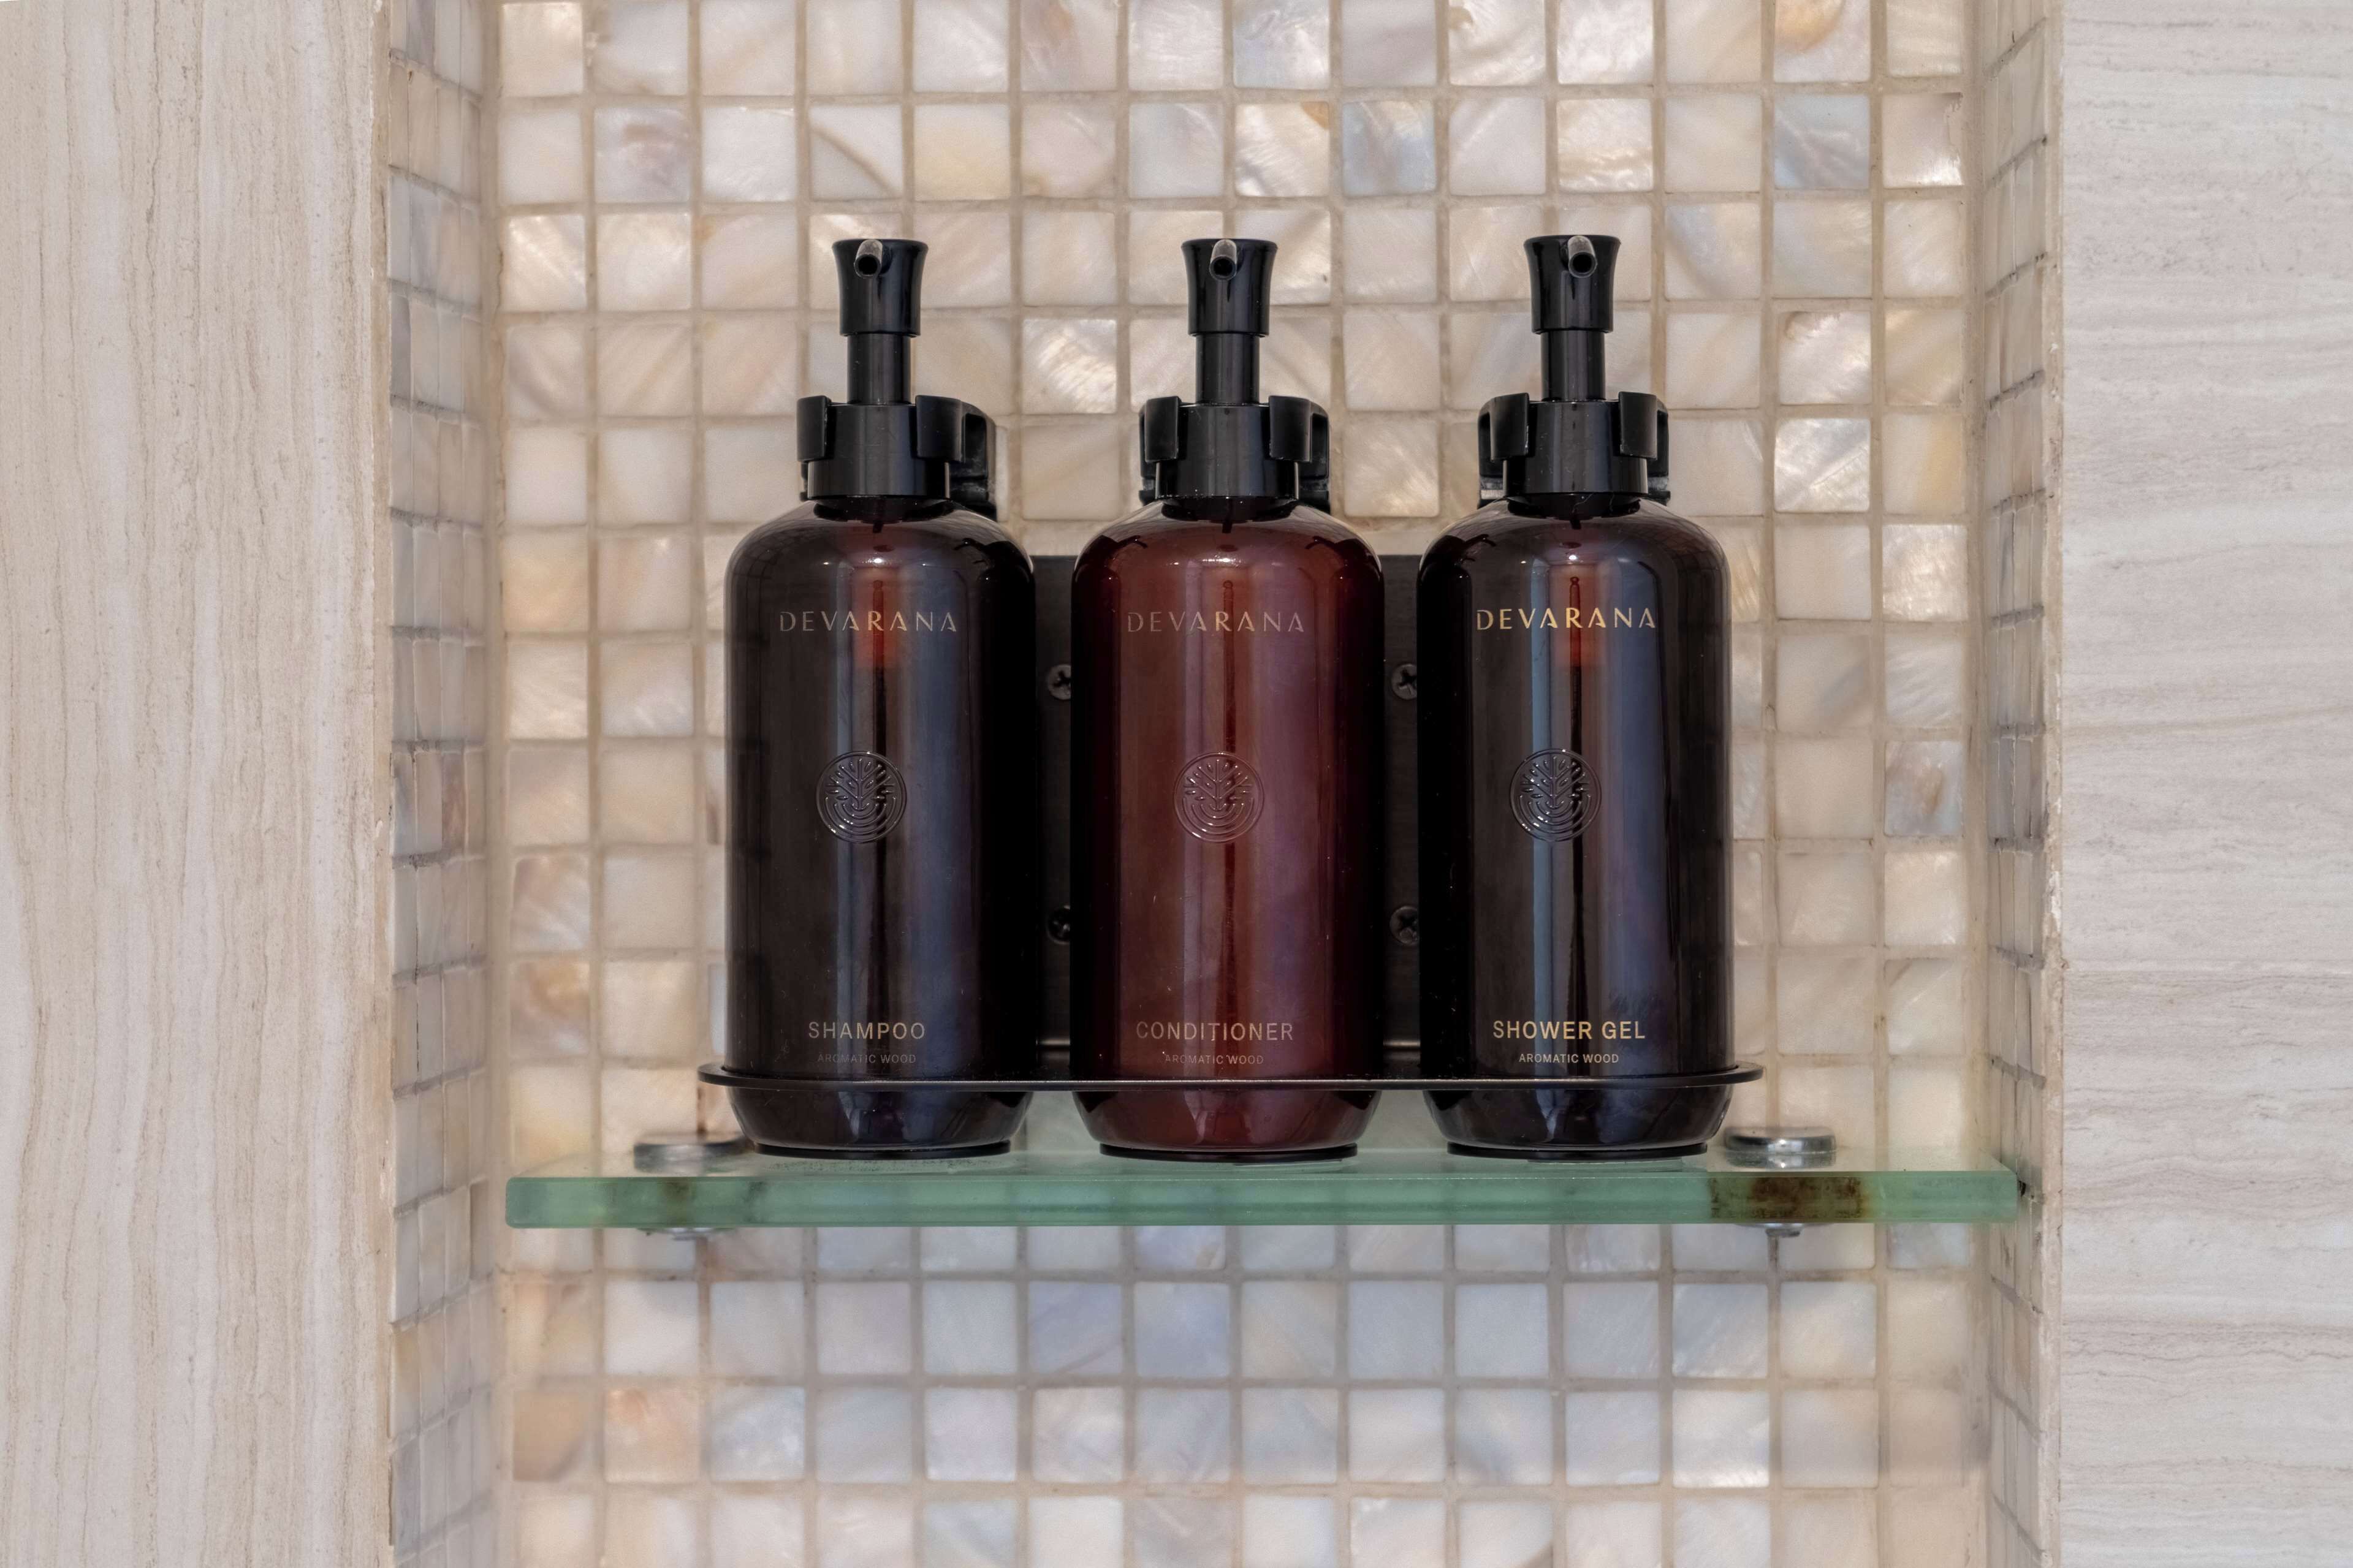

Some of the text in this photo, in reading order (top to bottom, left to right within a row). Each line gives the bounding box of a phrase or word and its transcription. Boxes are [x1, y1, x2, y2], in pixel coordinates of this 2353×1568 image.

[779, 610, 957, 632] DEVARANA
[1127, 611, 1304, 632] DEVARANA
[1476, 607, 1655, 630] DEVARANA
[808, 1021, 925, 1040] SHAMPOO
[1136, 1021, 1293, 1040] CONDITIONER
[1492, 1020, 1646, 1040] SHOWER GEL
[817, 1053, 916, 1064] AROMATIC WOOD
[1165, 1054, 1264, 1064] AROMATIC WOOD
[1518, 1053, 1619, 1063] AROMATIC WOOD
